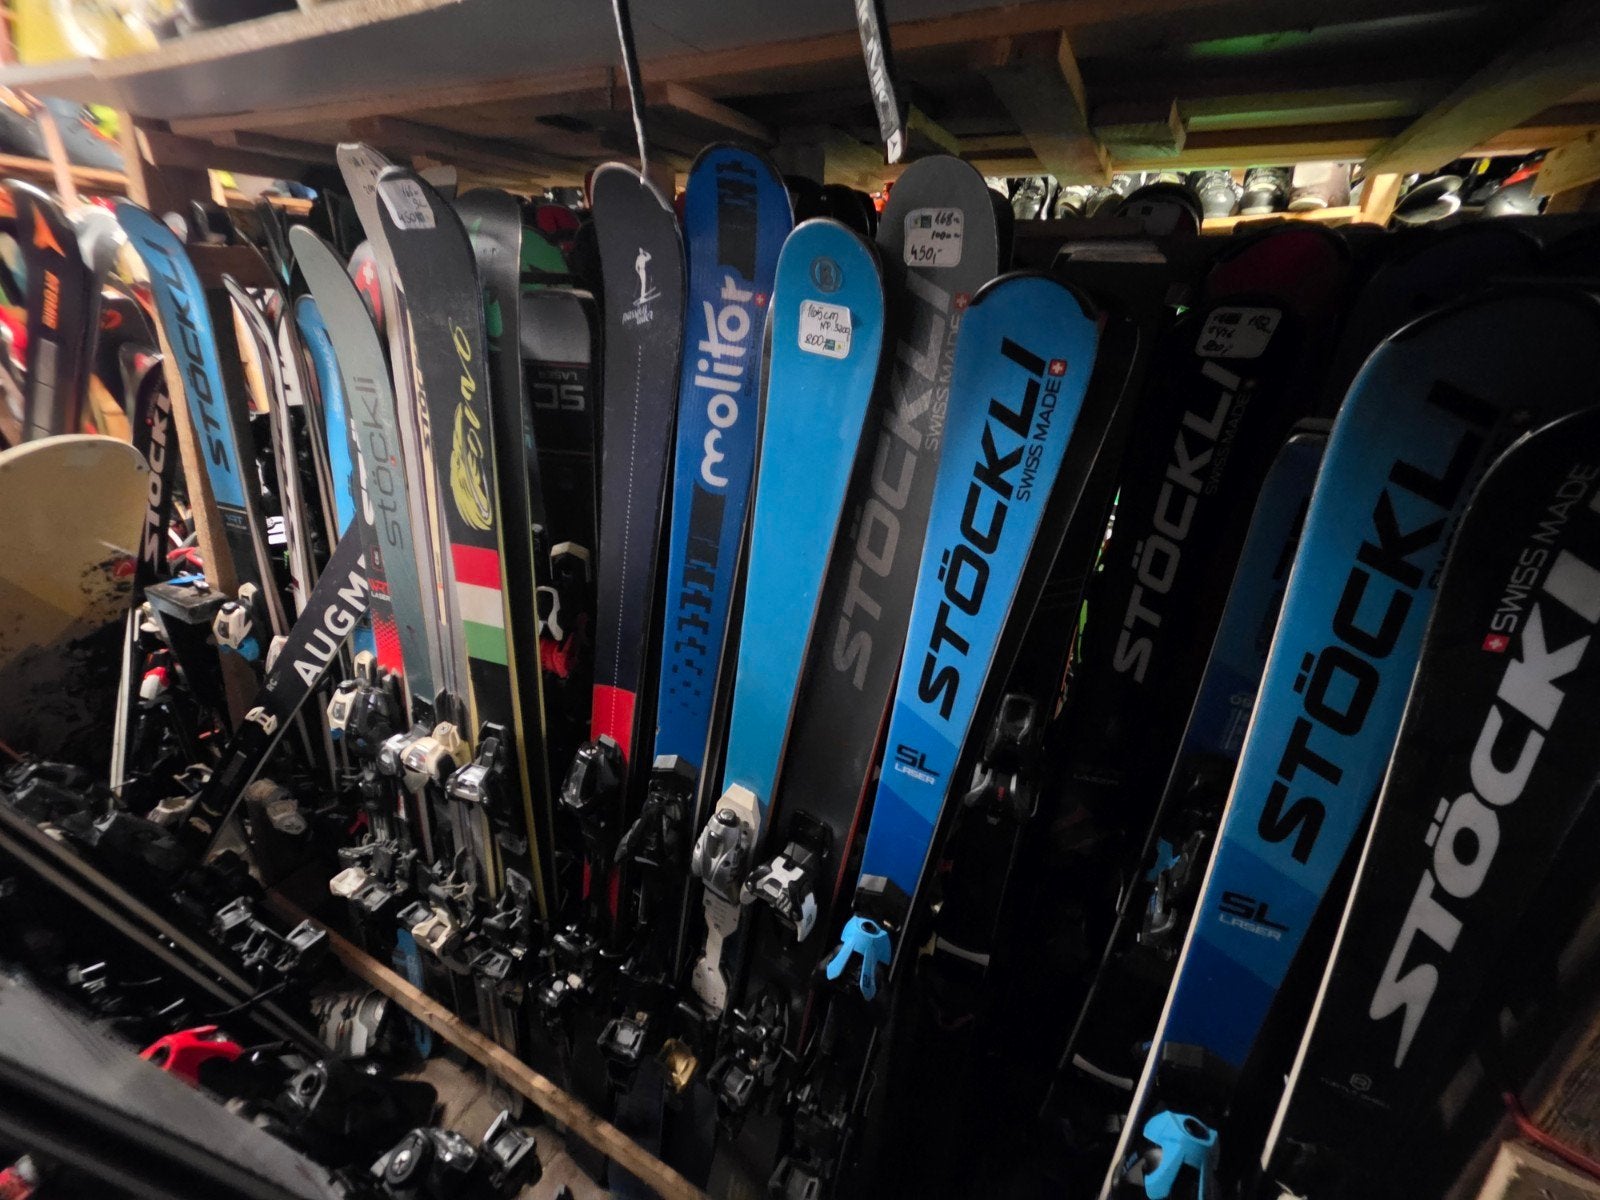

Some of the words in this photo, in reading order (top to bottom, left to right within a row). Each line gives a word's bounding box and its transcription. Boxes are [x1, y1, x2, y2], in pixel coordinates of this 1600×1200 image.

[694, 275, 753, 488] molitor
[1016, 443, 1044, 503] SWISS
[1033, 378, 1062, 442] MADE
[832, 265, 951, 692] STÖCKLI
[918, 336, 1047, 721] STÖCKLI
[1112, 360, 1242, 686] STÖCKLI
[1490, 548, 1548, 634] SWISS
[1530, 464, 1599, 545] MADE
[293, 554, 369, 688] AUGM
[1257, 379, 1499, 866] STÖCKLI
[894, 762, 935, 785] LASER
[895, 744, 940, 777] SL
[1368, 490, 1600, 1070] STÖCKL
[1218, 891, 1290, 932] SL
[1219, 912, 1282, 942] LASER
